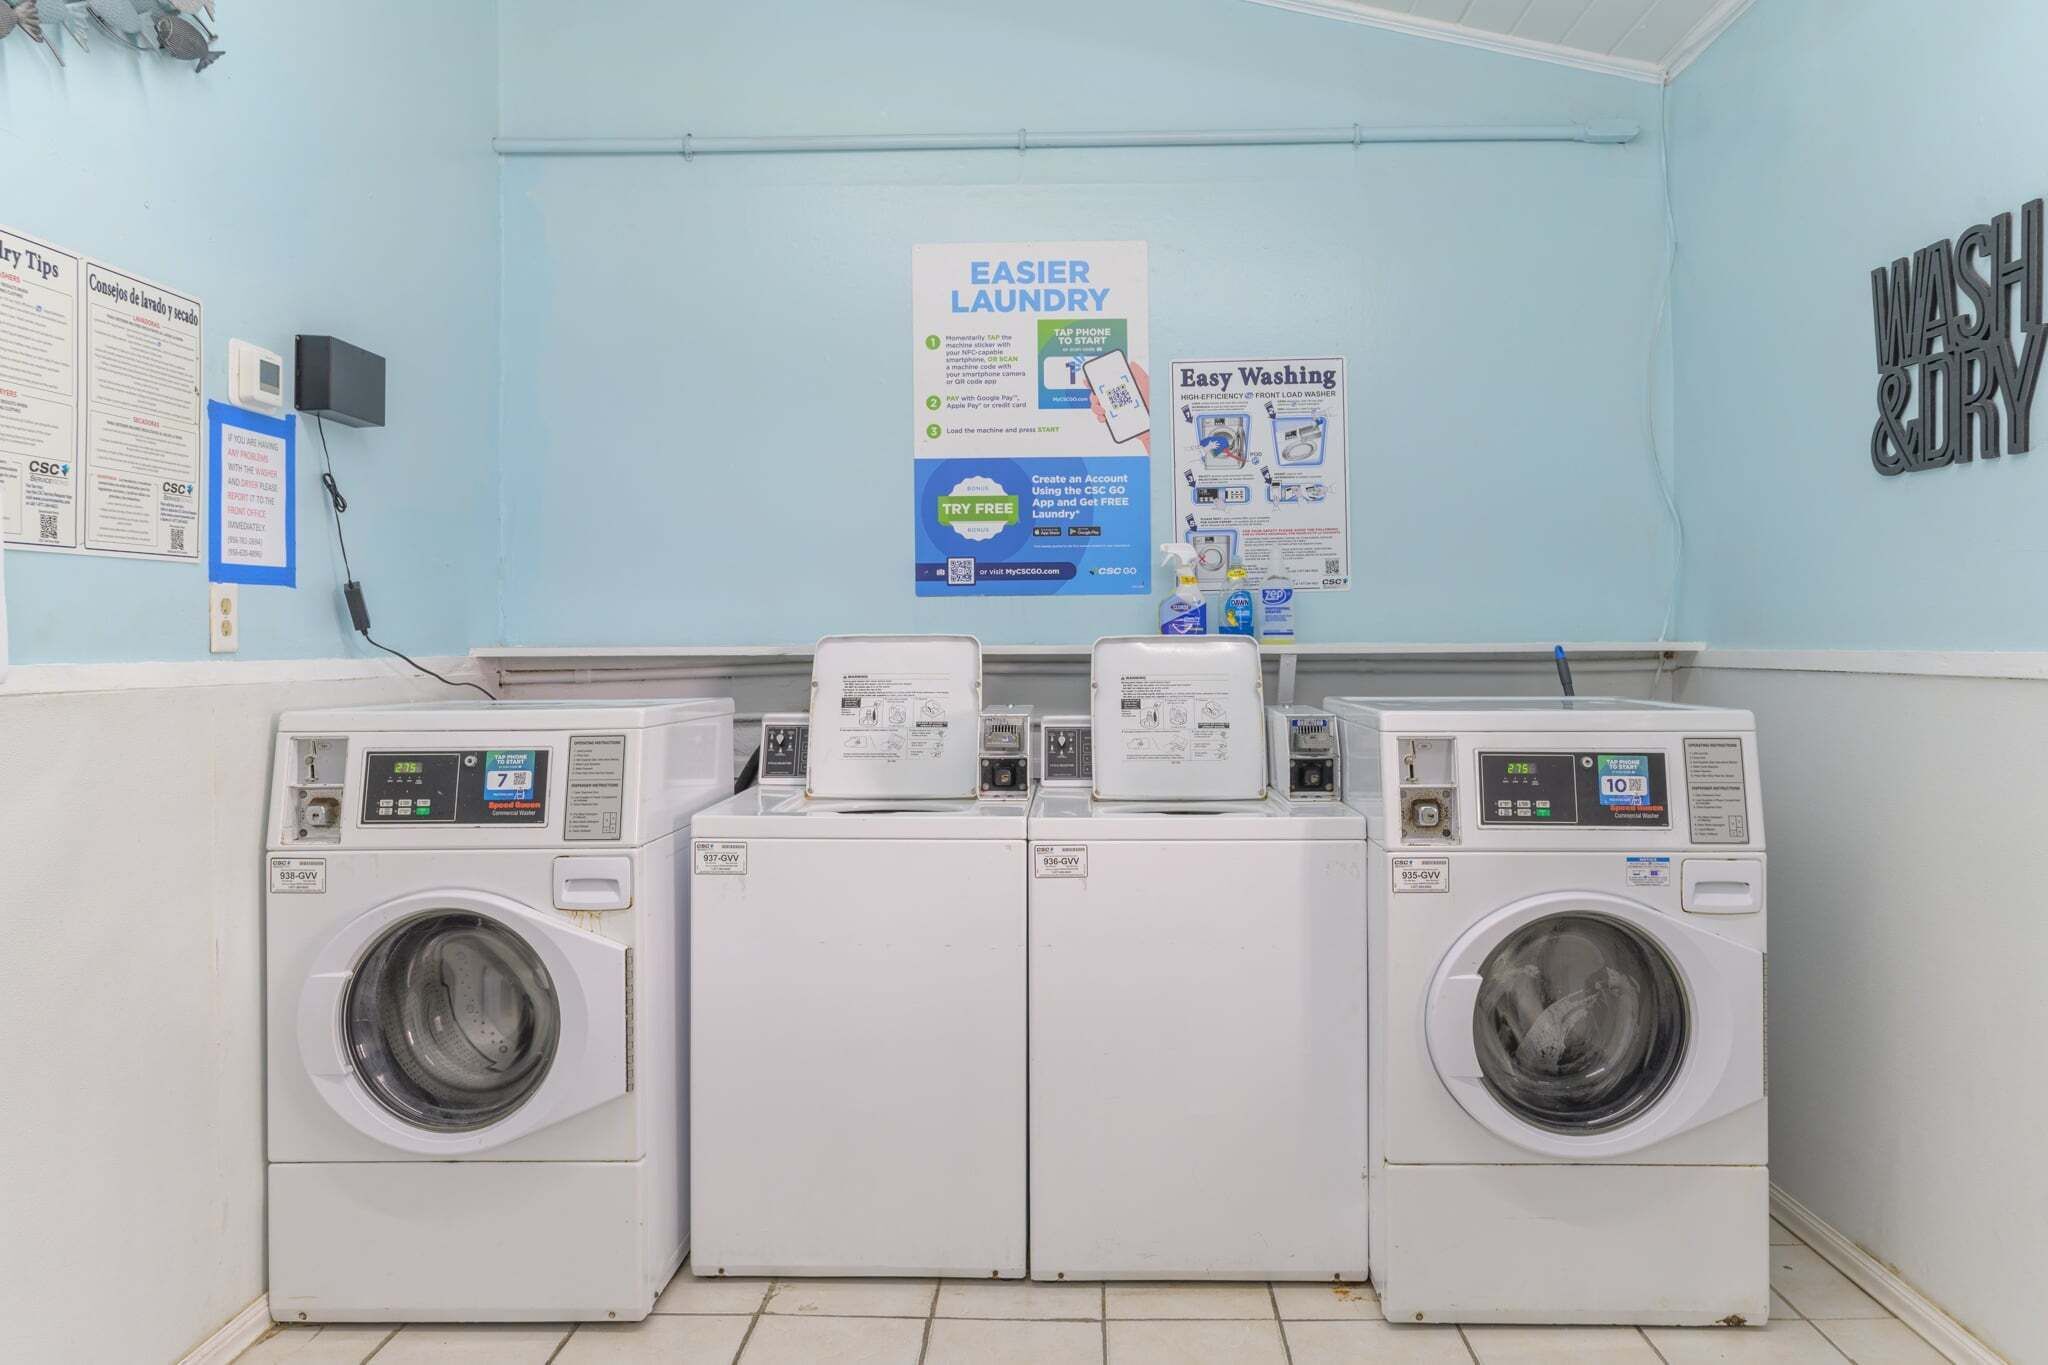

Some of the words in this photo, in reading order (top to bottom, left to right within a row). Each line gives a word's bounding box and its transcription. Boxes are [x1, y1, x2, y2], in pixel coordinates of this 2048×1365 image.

[25, 249, 59, 280] Tips
[971, 260, 1090, 284] EASIER
[1870, 198, 2043, 374] WASH
[89, 273, 128, 303] Consejos
[129, 287, 140, 306] de
[141, 291, 166, 316] lavado
[167, 305, 173, 321] y
[174, 306, 198, 326] secado
[951, 288, 1110, 313] LAUNDRY
[1054, 328, 1074, 336] TAP
[1076, 328, 1111, 336] PHONE
[1058, 337, 1072, 345] TO
[1074, 336, 1107, 344] START
[1065, 361, 1076, 384] 1
[1180, 368, 1233, 392] Easy
[1238, 365, 1337, 390] Washing
[1304, 390, 1336, 398] WASHER
[930, 398, 938, 408] 2
[930, 426, 938, 437] 3
[228, 433, 233, 442] IF
[234, 434, 246, 446] YOU
[246, 437, 257, 447] ARE
[227, 448, 239, 458] ANY
[29, 460, 60, 475] CSC
[228, 463, 242, 473] WITH
[243, 465, 255, 475] THE
[228, 477, 240, 488] AND
[259, 481, 278, 492] PLEASE
[1031, 475, 1066, 484] Create
[1084, 474, 1128, 483] Account
[162, 481, 186, 495] CSC
[1031, 486, 1062, 496] Using
[1064, 486, 1082, 495] the
[1084, 486, 1106, 495] CSC
[1109, 486, 1126, 494] GO
[227, 491, 249, 503] REPORT
[256, 495, 264, 504] TO
[264, 496, 275, 506] THE
[1031, 498, 1054, 508] App
[1056, 498, 1077, 507] and
[1079, 497, 1098, 506] Get
[1100, 497, 1129, 506] FREE
[247, 508, 267, 519] OFFICE
[942, 503, 971, 515] TRY
[975, 502, 1014, 514] FREE
[1005, 568, 1060, 576] MyCSCGO.com
[1098, 567, 1122, 575] CSC
[1123, 567, 1137, 575] GO
[497, 773, 508, 788] 7
[1606, 778, 1627, 793] 10
[488, 801, 514, 809] Speed
[703, 854, 739, 862] 937-GVV
[1043, 857, 1080, 865] 936-GVV
[280, 871, 318, 880] 938-GVV
[1401, 871, 1441, 880] 935-GVV
